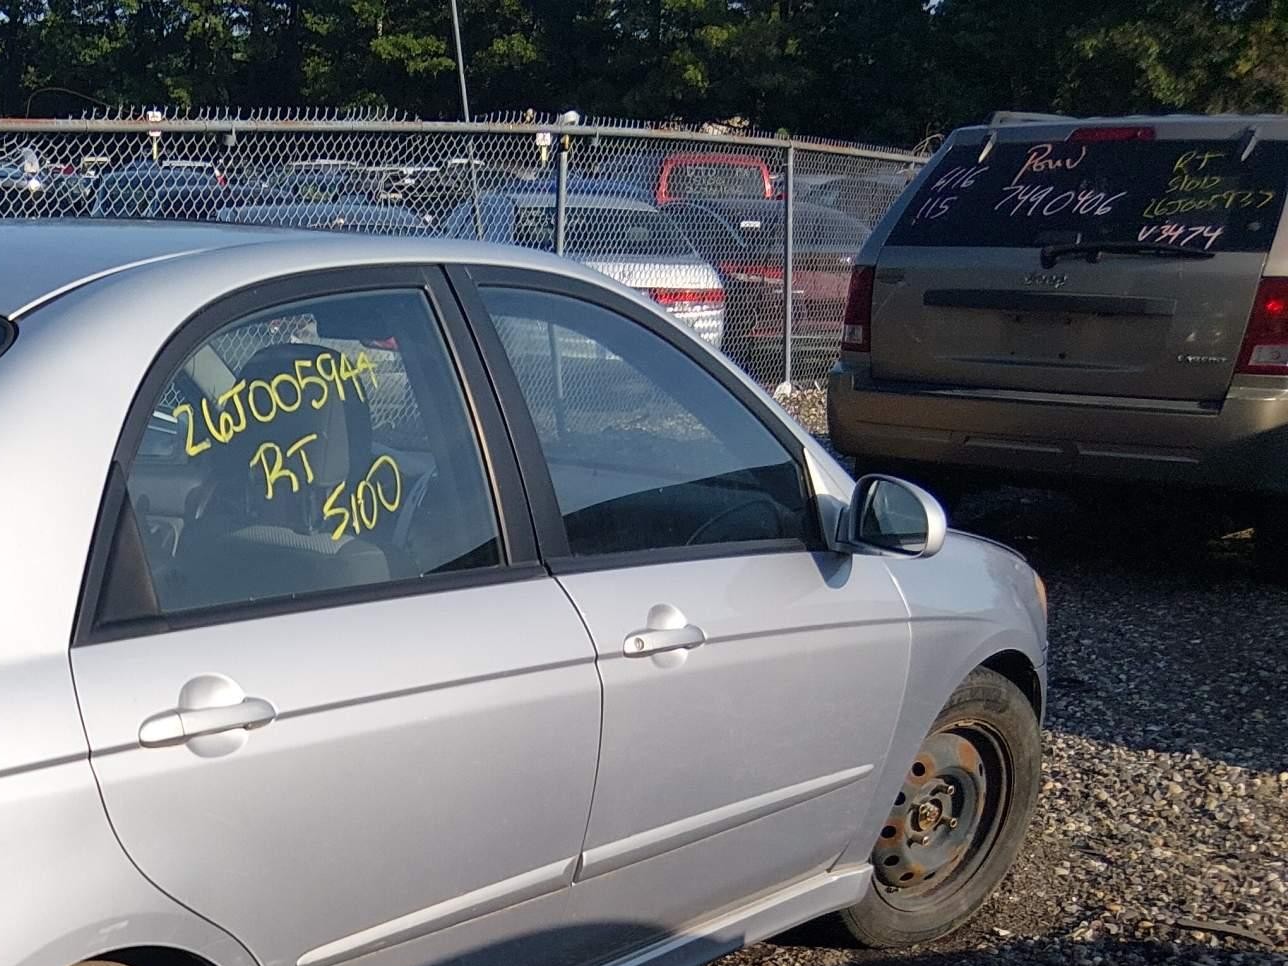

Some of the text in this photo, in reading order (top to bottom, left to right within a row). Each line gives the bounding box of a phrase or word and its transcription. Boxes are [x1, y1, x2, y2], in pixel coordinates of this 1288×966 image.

[172, 352, 379, 457] 26J005944
[249, 433, 318, 499] RT
[323, 455, 403, 541] S100
